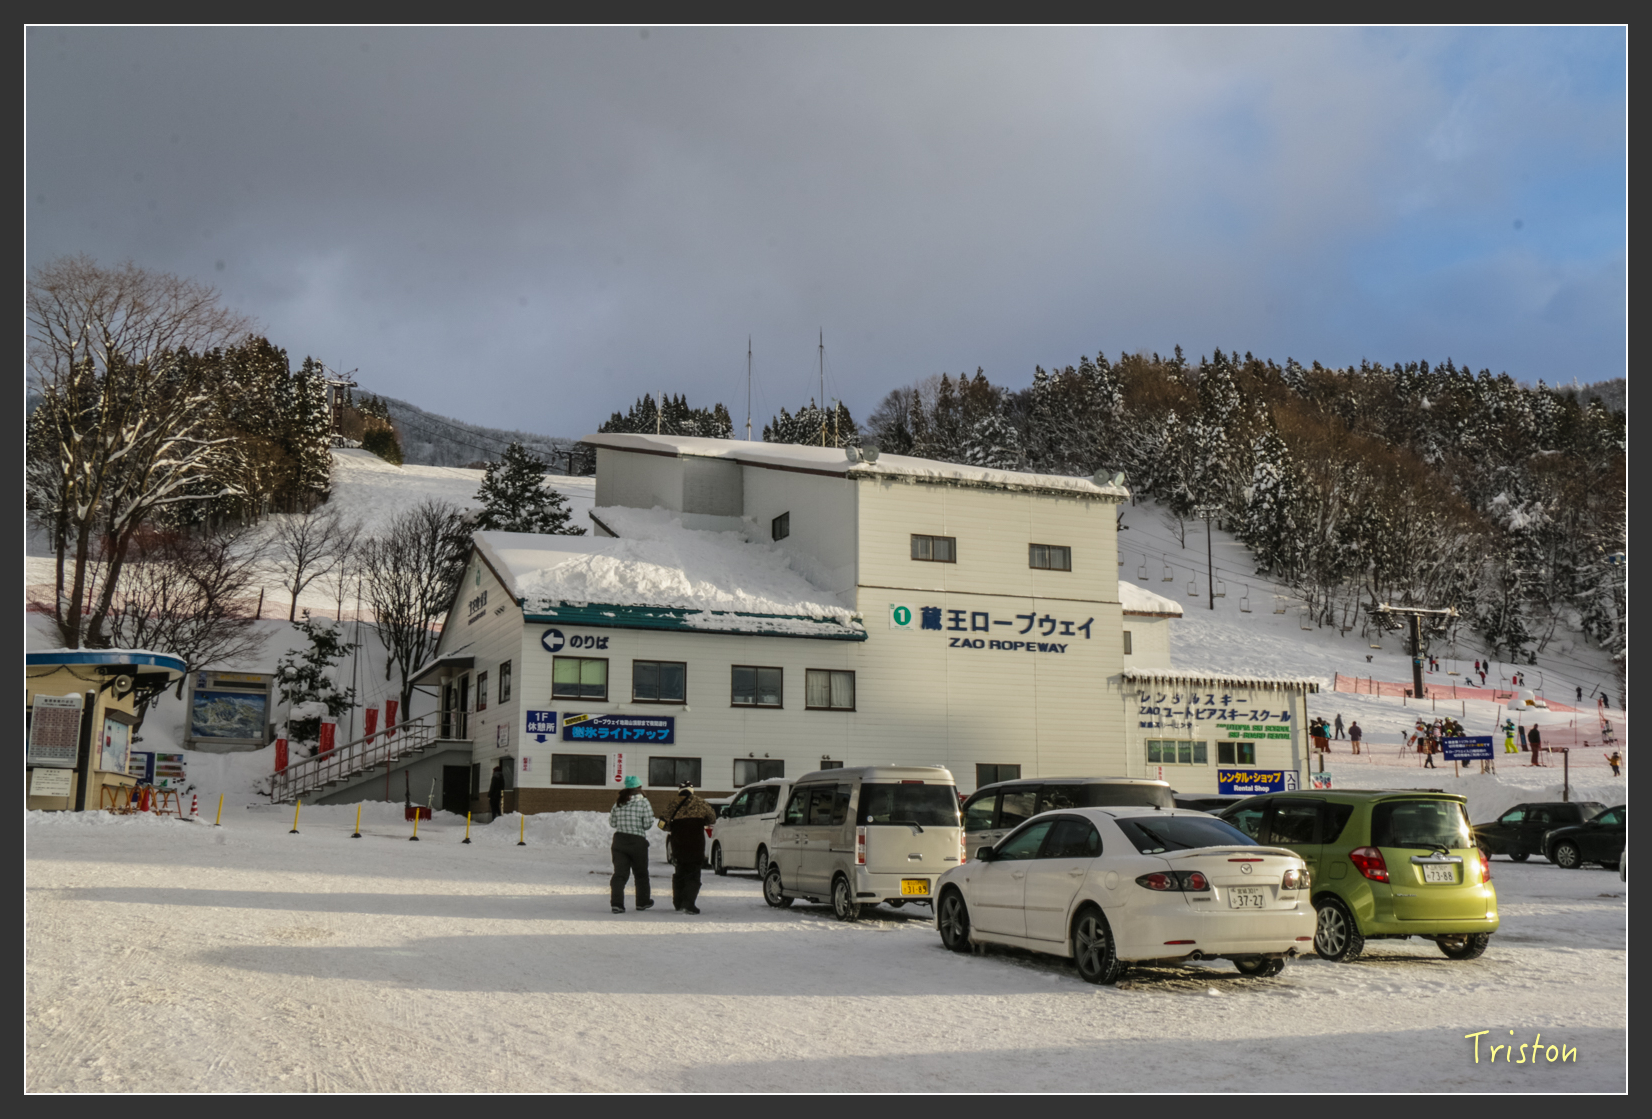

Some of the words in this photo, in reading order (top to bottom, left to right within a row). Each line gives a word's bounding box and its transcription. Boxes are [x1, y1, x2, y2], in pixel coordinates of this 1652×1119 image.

[920, 606, 1095, 639] 蔵王ロープウェイ
[570, 634, 609, 650] のりば
[949, 638, 985, 649] ZAO
[989, 640, 1068, 653] ROPEWAY
[535, 712, 549, 721] 1F
[528, 722, 555, 732] 休憩所
[572, 726, 670, 740] 樹氷ライトアップ
[1220, 772, 1282, 783] レンタル・ショップ
[1254, 785, 1270, 793] Shop
[1431, 871, 1453, 881] 73-88
[1237, 895, 1263, 906] 37-27
